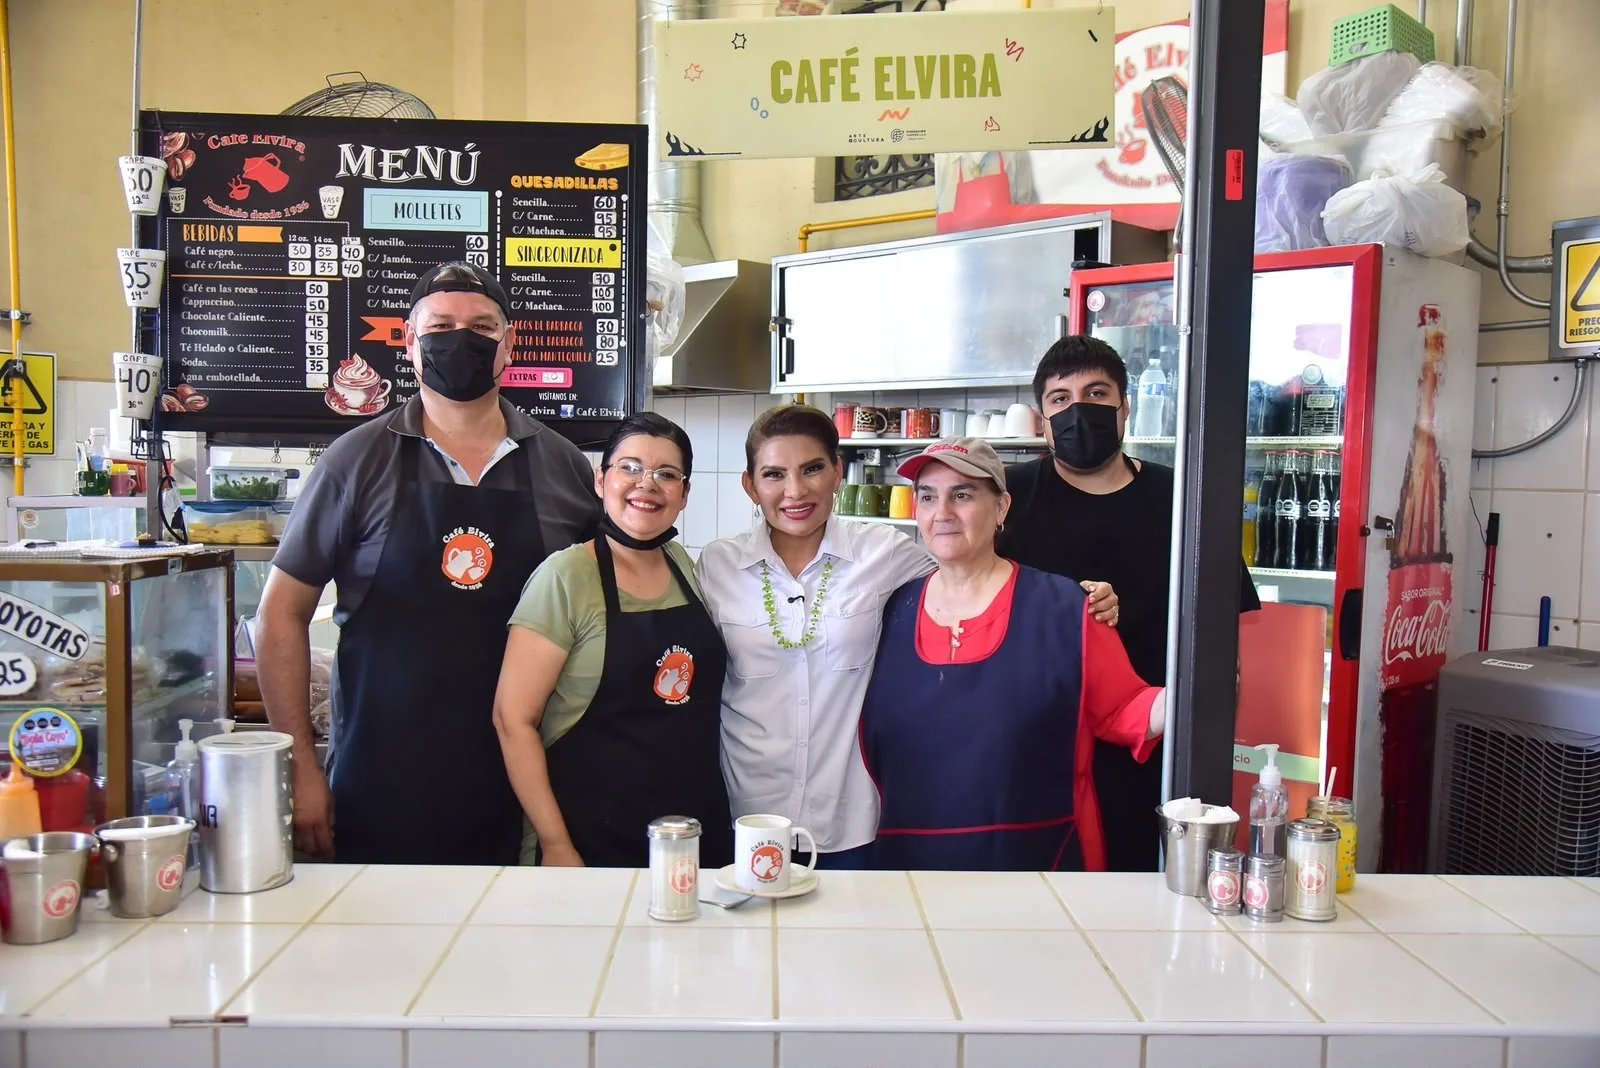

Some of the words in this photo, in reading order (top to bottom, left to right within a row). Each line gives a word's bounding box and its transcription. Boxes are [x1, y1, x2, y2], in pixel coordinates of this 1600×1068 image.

[770, 46, 861, 104] CAFÉ
[874, 53, 1002, 101] ELVIRA
[252, 134, 306, 154] Elvira
[334, 142, 482, 186] MENÚ
[126, 167, 153, 193] 30
[511, 175, 619, 191] QUESADILLAS
[132, 195, 143, 205] 12
[322, 196, 340, 204] VASO
[512, 197, 548, 208] Sencilla
[595, 196, 615, 209] 60
[202, 195, 248, 219] Fundado
[250, 210, 282, 219] desde
[394, 202, 462, 221] MOLLETES
[512, 211, 524, 221] C/
[526, 211, 554, 221] Carne
[596, 213, 615, 225] 95
[182, 224, 234, 242] BEBIDAS
[512, 226, 524, 236] C/
[527, 226, 565, 236] Machaca
[596, 226, 615, 237] 95
[368, 237, 405, 247] Sencillo
[466, 236, 485, 250] 60
[184, 247, 207, 256] Café
[208, 248, 234, 258] negro
[292, 245, 307, 256] 30
[318, 247, 332, 257] 35
[344, 247, 360, 259] 40
[367, 253, 379, 264] C/
[381, 253, 412, 264] Jamón
[517, 245, 604, 265] SINCRONIZADA
[185, 261, 207, 270] Café
[209, 261, 242, 271] c/leche
[290, 261, 306, 272] 30
[319, 262, 334, 273] 35
[344, 263, 360, 275] 40
[123, 262, 151, 290] 35
[366, 270, 378, 280] C/
[381, 270, 417, 281] Chorizo
[511, 273, 546, 282] Sencilla
[130, 291, 142, 300] 14
[182, 285, 205, 294] Café
[217, 285, 232, 294] las
[309, 285, 323, 294] 50
[367, 285, 379, 295] C/
[381, 285, 409, 295] Carne
[510, 287, 523, 296] C/
[524, 287, 552, 296] Carne
[595, 288, 612, 299] 100
[182, 298, 235, 309] Cappuccino
[309, 300, 325, 311] 50
[367, 299, 379, 309] C/
[381, 299, 411, 309] Macha
[510, 301, 523, 311] C/
[525, 301, 563, 311] Machaca
[595, 301, 612, 313] 100
[181, 312, 225, 322] Chocolate
[228, 313, 266, 322] Caliente
[308, 315, 324, 326] 45
[510, 320, 533, 332] TACOS
[535, 321, 544, 332] DE
[546, 320, 584, 332] BARBACOA
[598, 321, 615, 333] 30
[1569, 327, 1600, 338] RIESGO
[180, 327, 229, 337] Chocomilk
[308, 330, 324, 341] 45
[511, 335, 535, 347] ORTA
[536, 335, 545, 347] DE
[546, 335, 584, 347] BARBACOA
[599, 336, 615, 348] 80
[179, 343, 192, 352] Té
[193, 344, 227, 353] Helado
[236, 345, 274, 354] Caliente
[308, 346, 324, 356] 35
[122, 355, 148, 364] CAFE
[511, 351, 523, 362] AN
[525, 351, 537, 362] CON
[539, 351, 593, 364] MANTEQUILLA
[596, 351, 615, 364] 25
[181, 358, 207, 367] Sodas
[308, 360, 324, 371] 35
[118, 368, 151, 394] 40
[180, 373, 204, 384] Agua
[206, 373, 261, 383] embotellada
[396, 378, 420, 388] Mach
[509, 373, 538, 382] EXTRAS
[538, 391, 567, 401] VISÍTANOS
[569, 393, 579, 401] EN:
[516, 406, 556, 416] fe_elvira
[576, 407, 598, 417] Café
[38, 422, 46, 430] Y
[27, 431, 40, 439] DE
[28, 440, 49, 449] GAS
[442, 527, 465, 544] Café
[467, 526, 495, 549] Elvira
[1400, 588, 1419, 601] SABOR
[0, 600, 87, 658] OYOTAS
[656, 648, 671, 667] Café
[672, 645, 693, 661] Elvira
[1234, 753, 1250, 764] cio
